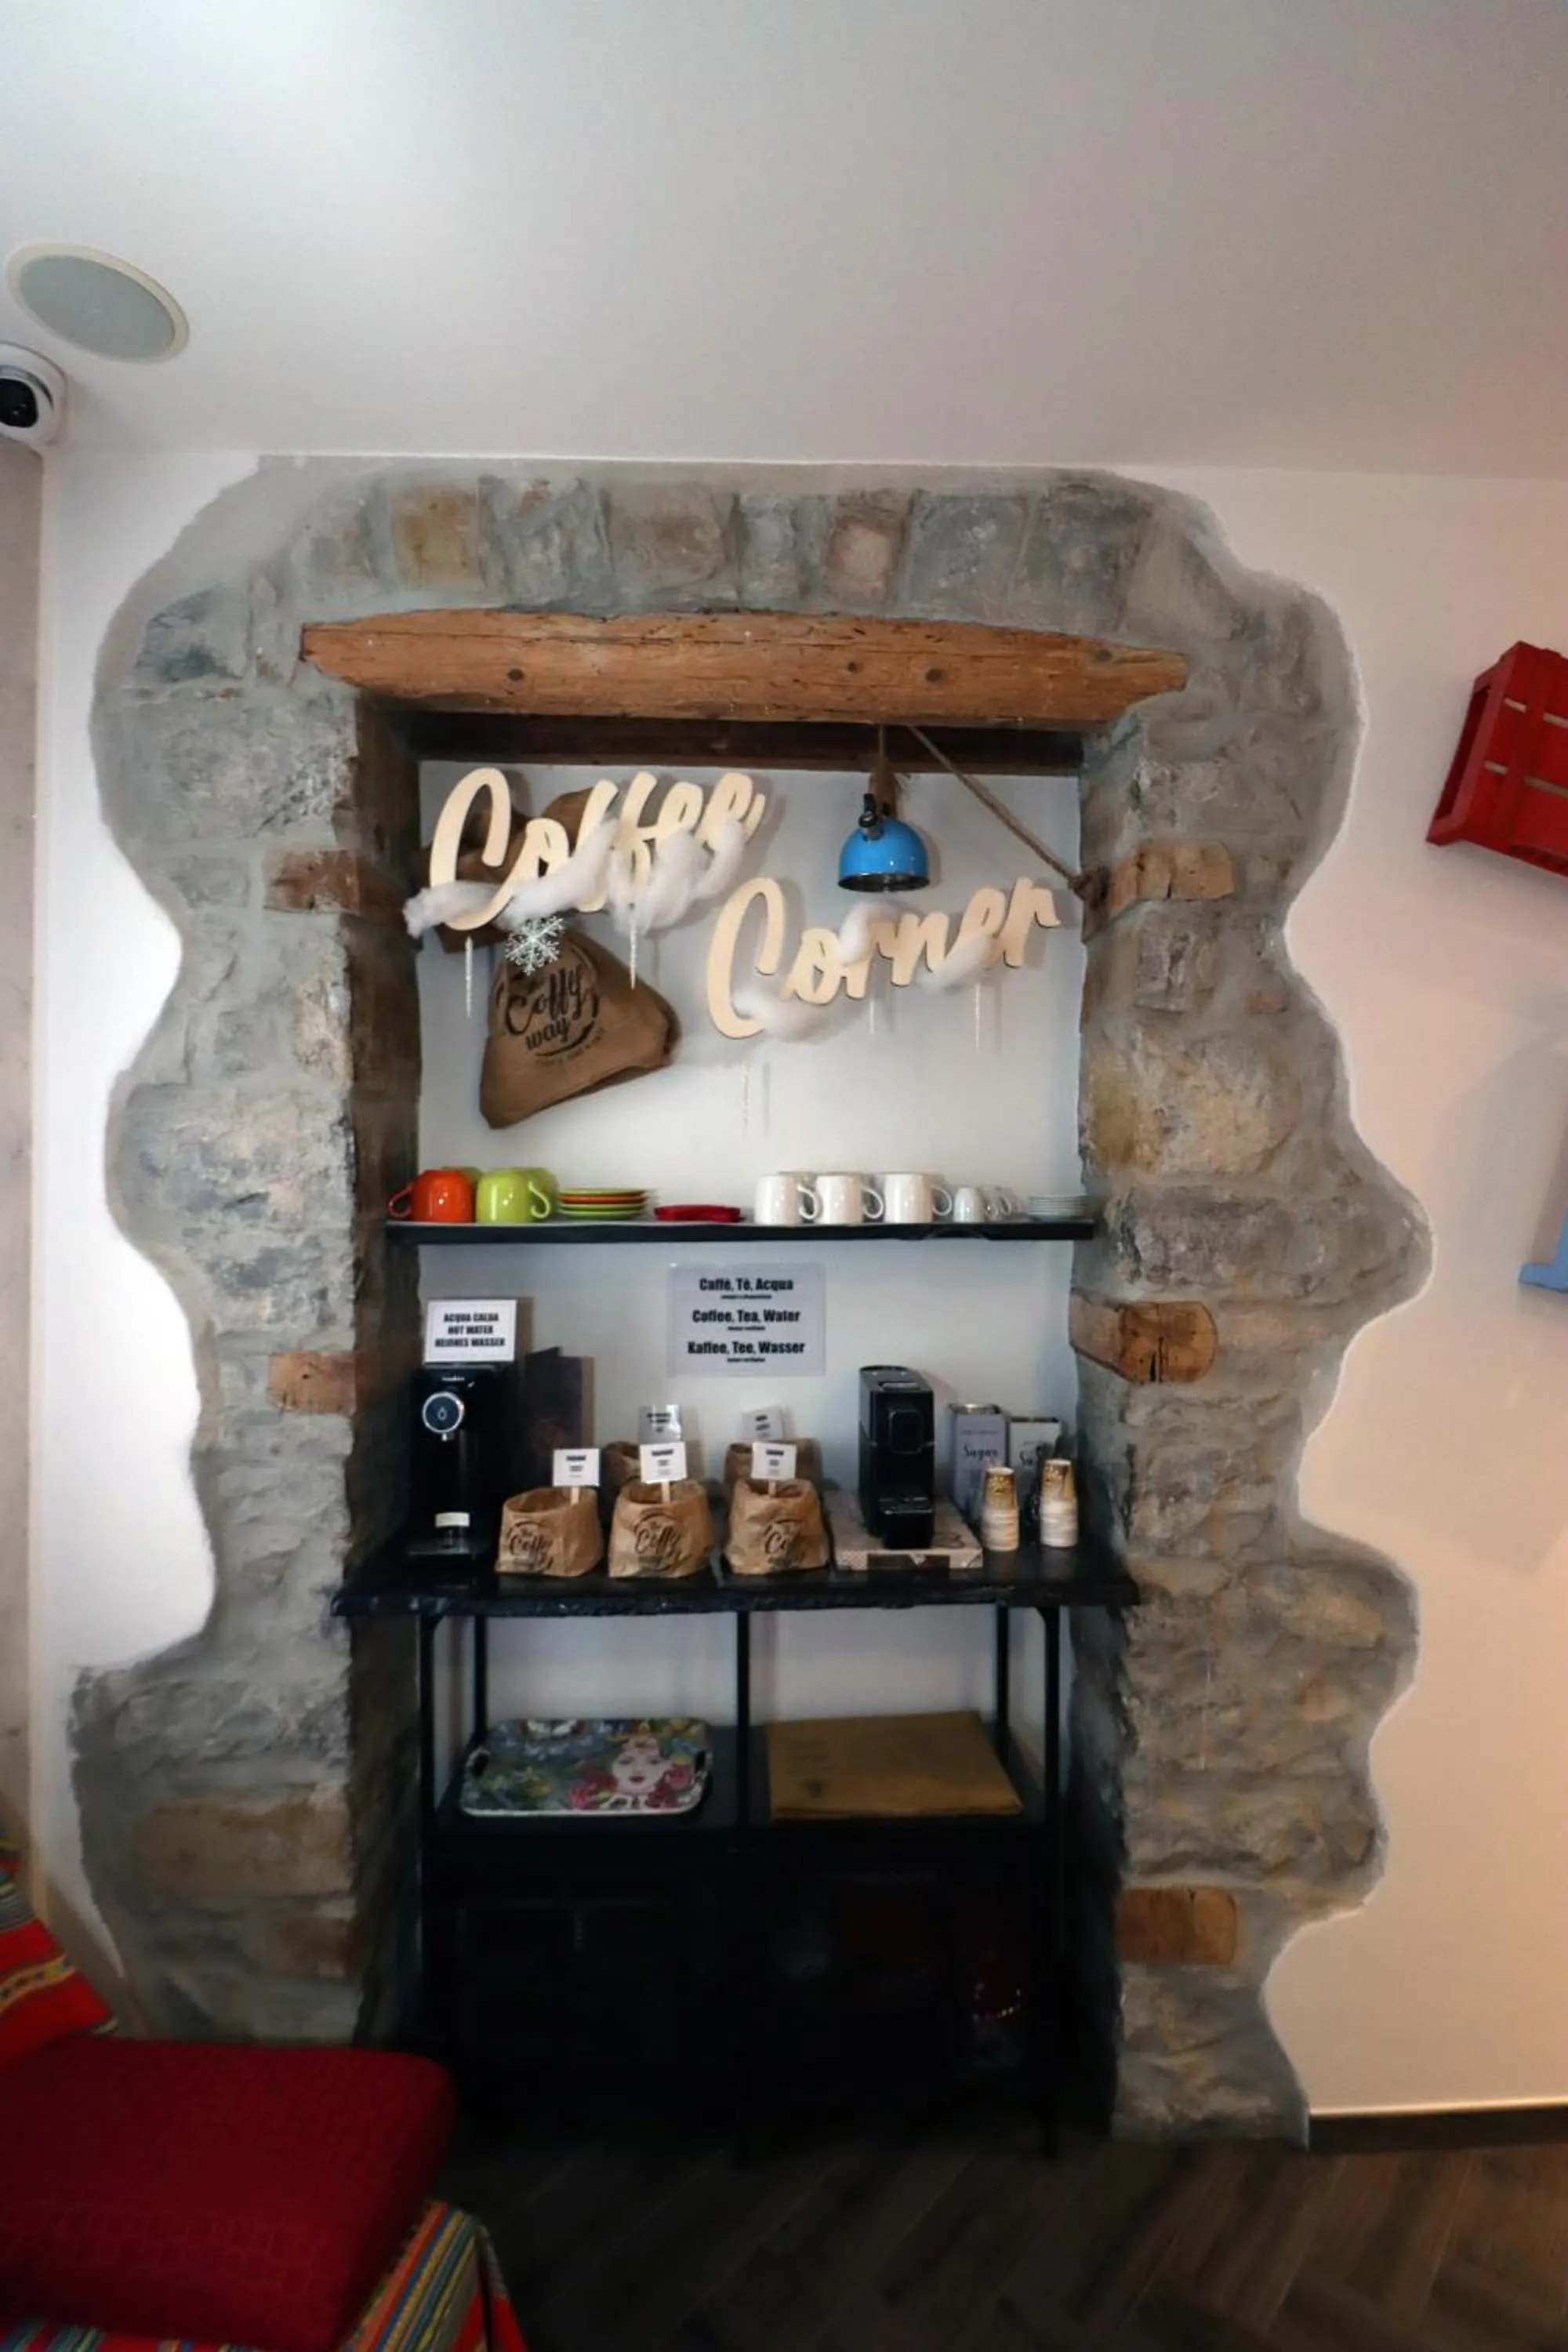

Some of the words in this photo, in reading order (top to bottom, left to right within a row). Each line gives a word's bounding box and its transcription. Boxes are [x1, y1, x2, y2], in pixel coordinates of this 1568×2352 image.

[430, 768, 766, 930] Coffee
[707, 877, 1061, 1039] Corner
[525, 1017, 571, 1051] way
[756, 1278, 793, 1292] Acqua
[444, 1312, 471, 1323] ACQUA
[473, 1312, 499, 1322] CALDA
[692, 1309, 735, 1323] Coffee,
[737, 1310, 760, 1323] Tea,
[764, 1310, 800, 1323] Water
[448, 1326, 463, 1334] HOT
[466, 1325, 493, 1334] WATER
[471, 1338, 505, 1347] WASSER
[688, 1341, 729, 1355] Kaffee,
[759, 1342, 805, 1354] Wasser
